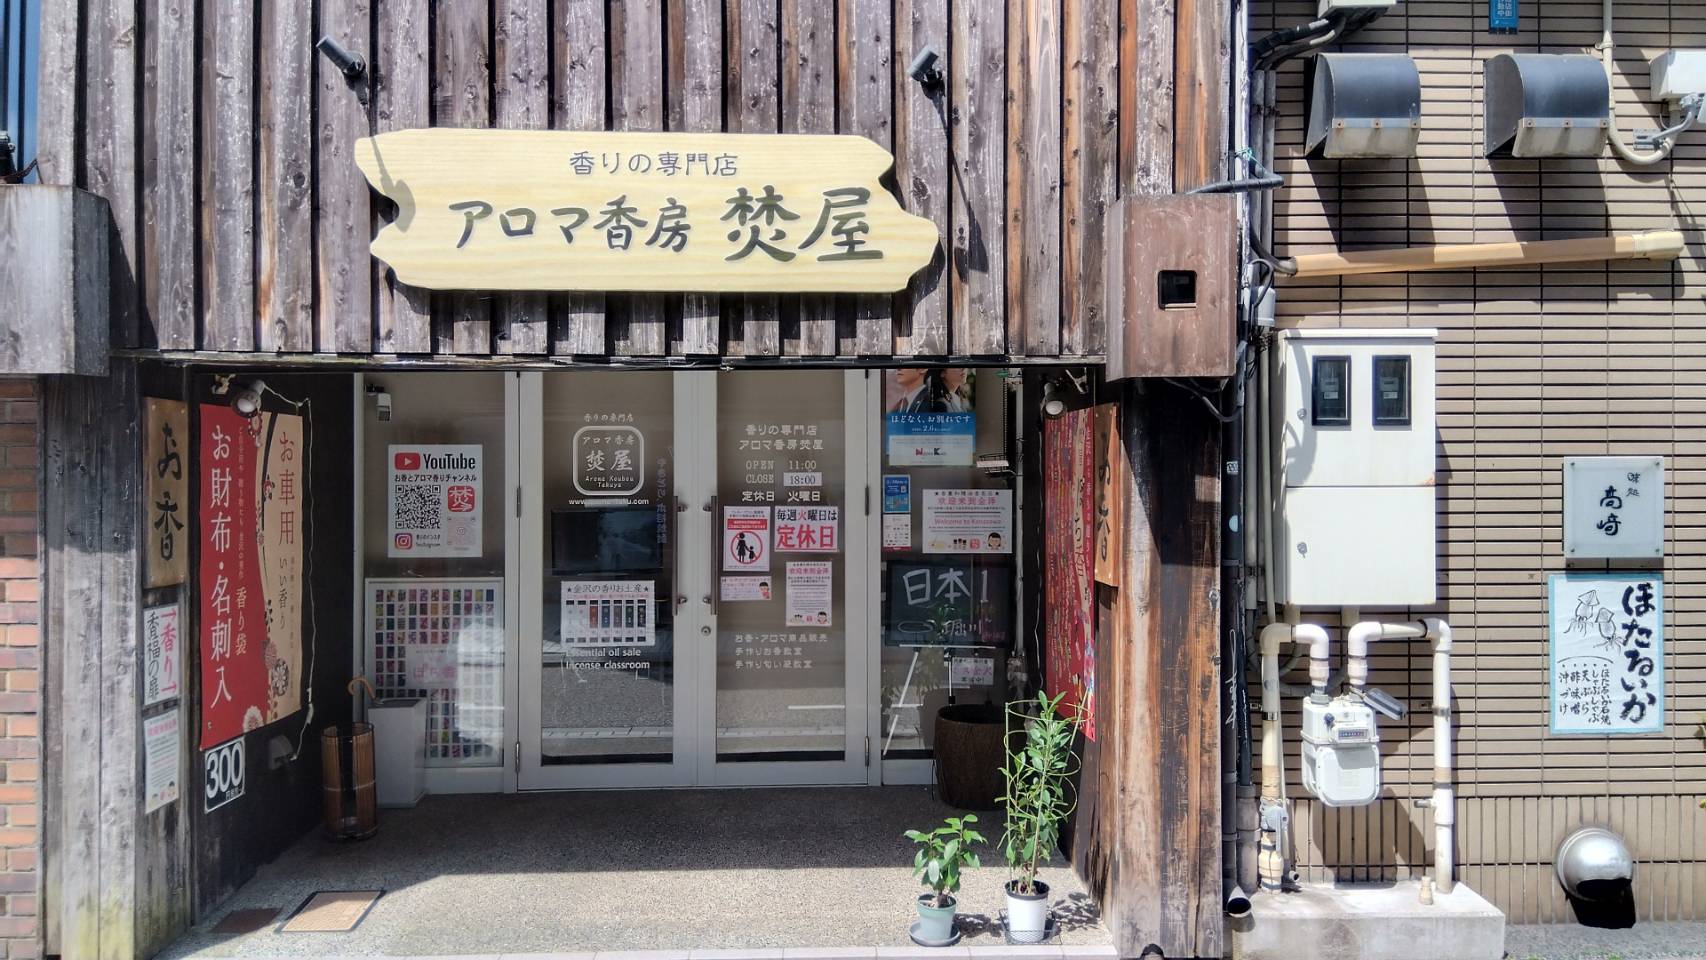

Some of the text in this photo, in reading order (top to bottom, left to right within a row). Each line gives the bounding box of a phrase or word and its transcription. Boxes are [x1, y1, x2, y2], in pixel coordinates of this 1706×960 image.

[569, 151, 739, 176] 香りの専門店
[449, 184, 884, 264] アロマ香房 焚屋
[745, 424, 818, 436] 香りの専門店
[423, 453, 476, 470] YouTube
[585, 449, 633, 472] 焚屋
[745, 460, 817, 470] OPEN 11:00
[745, 474, 816, 485] CLOSE 18:00
[279, 431, 296, 546] お車用
[741, 491, 820, 502] 定休日 火曜日
[777, 509, 837, 520] 毎週火曜日は
[776, 525, 834, 548] 定休日
[608, 648, 620, 657] oil
[622, 648, 642, 657] sale
[1620, 583, 1657, 724] ほたるいか
[604, 661, 650, 669] classroom
[206, 742, 244, 799] 300
